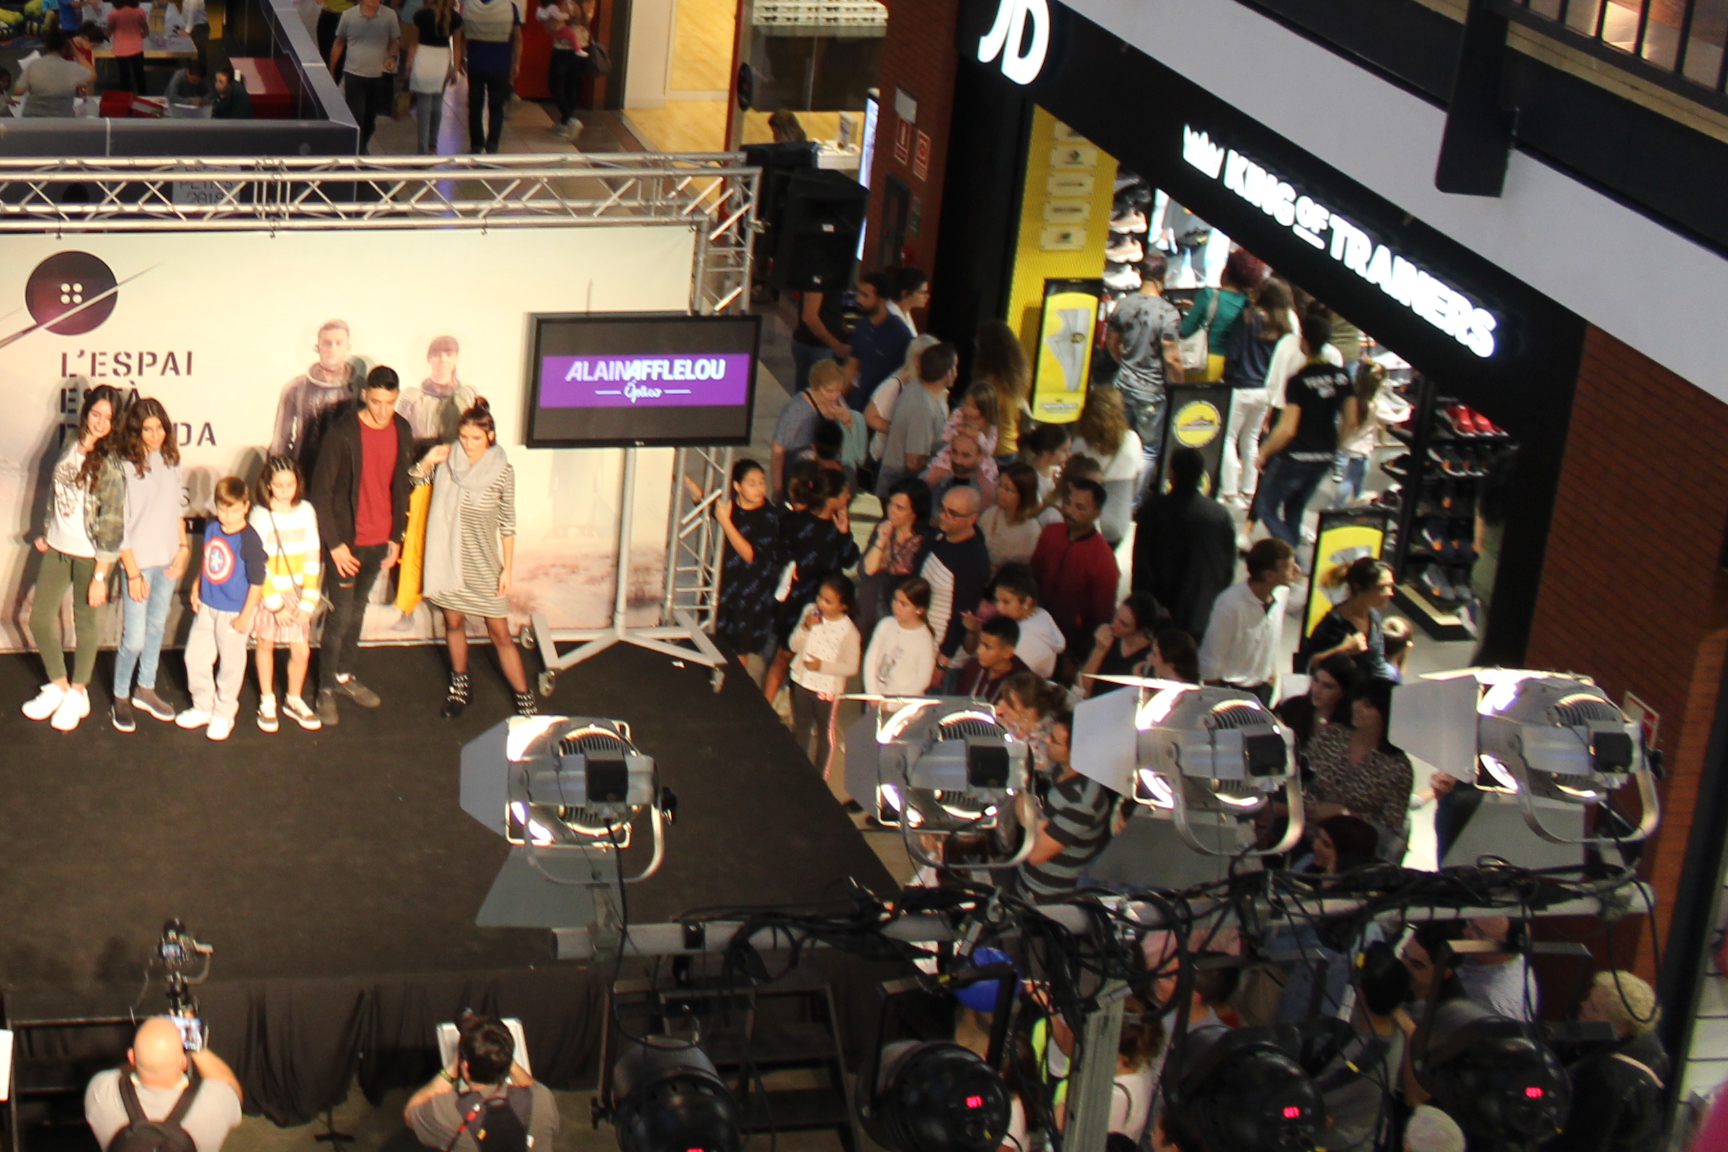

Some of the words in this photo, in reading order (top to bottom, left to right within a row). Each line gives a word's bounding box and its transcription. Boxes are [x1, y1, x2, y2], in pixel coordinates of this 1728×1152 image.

[1223, 148, 1297, 228] KING
[1294, 194, 1330, 250] OF
[1328, 212, 1498, 359] TRAINERS
[61, 349, 193, 378] L'ESPAI
[565, 360, 630, 382] ALAIN
[623, 358, 727, 381] AFFLELOU
